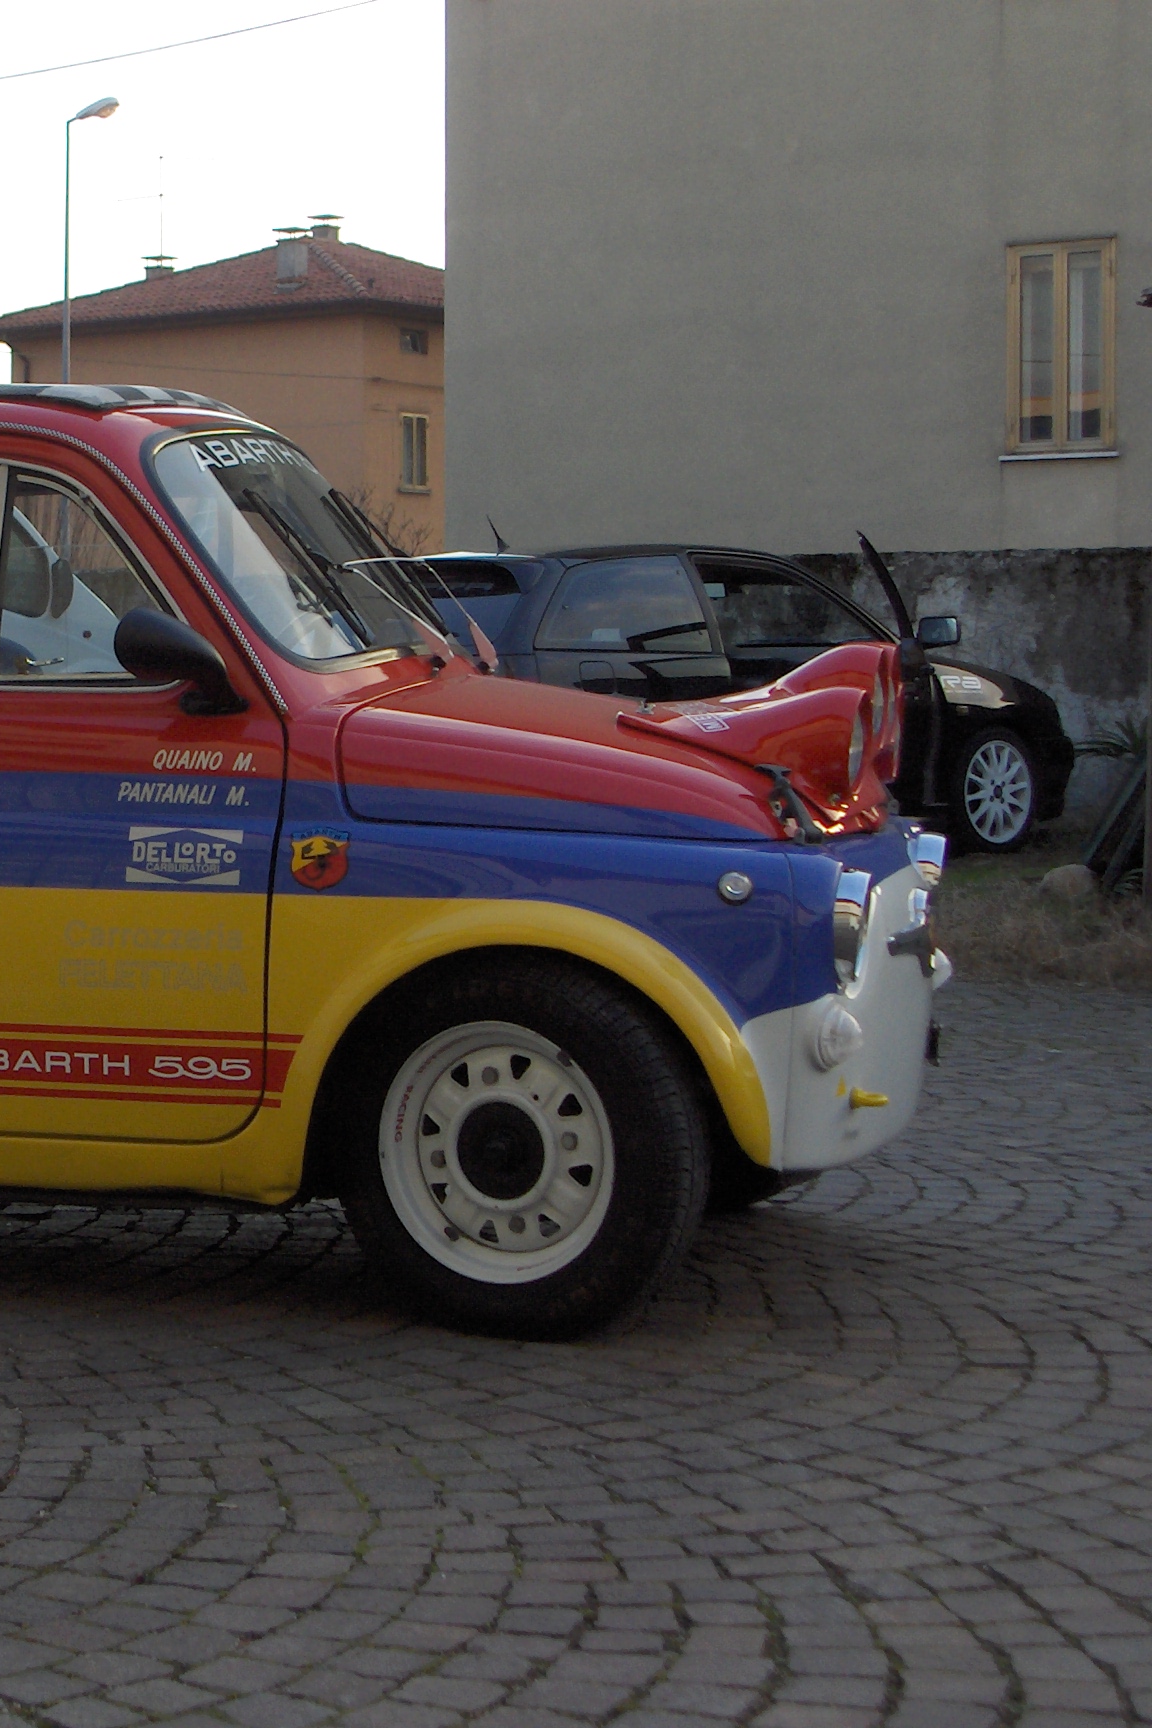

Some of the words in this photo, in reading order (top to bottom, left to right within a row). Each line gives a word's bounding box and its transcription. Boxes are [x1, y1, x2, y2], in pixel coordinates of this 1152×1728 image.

[188, 438, 302, 472] ABARTH
[152, 749, 223, 770] QUAINO
[232, 752, 257, 772] M.
[118, 781, 216, 805] PANTANALI
[225, 786, 249, 806] M.
[146, 862, 220, 874] CARBURATORI
[64, 918, 244, 951] Carrozzeria
[148, 1055, 252, 1081] 595
